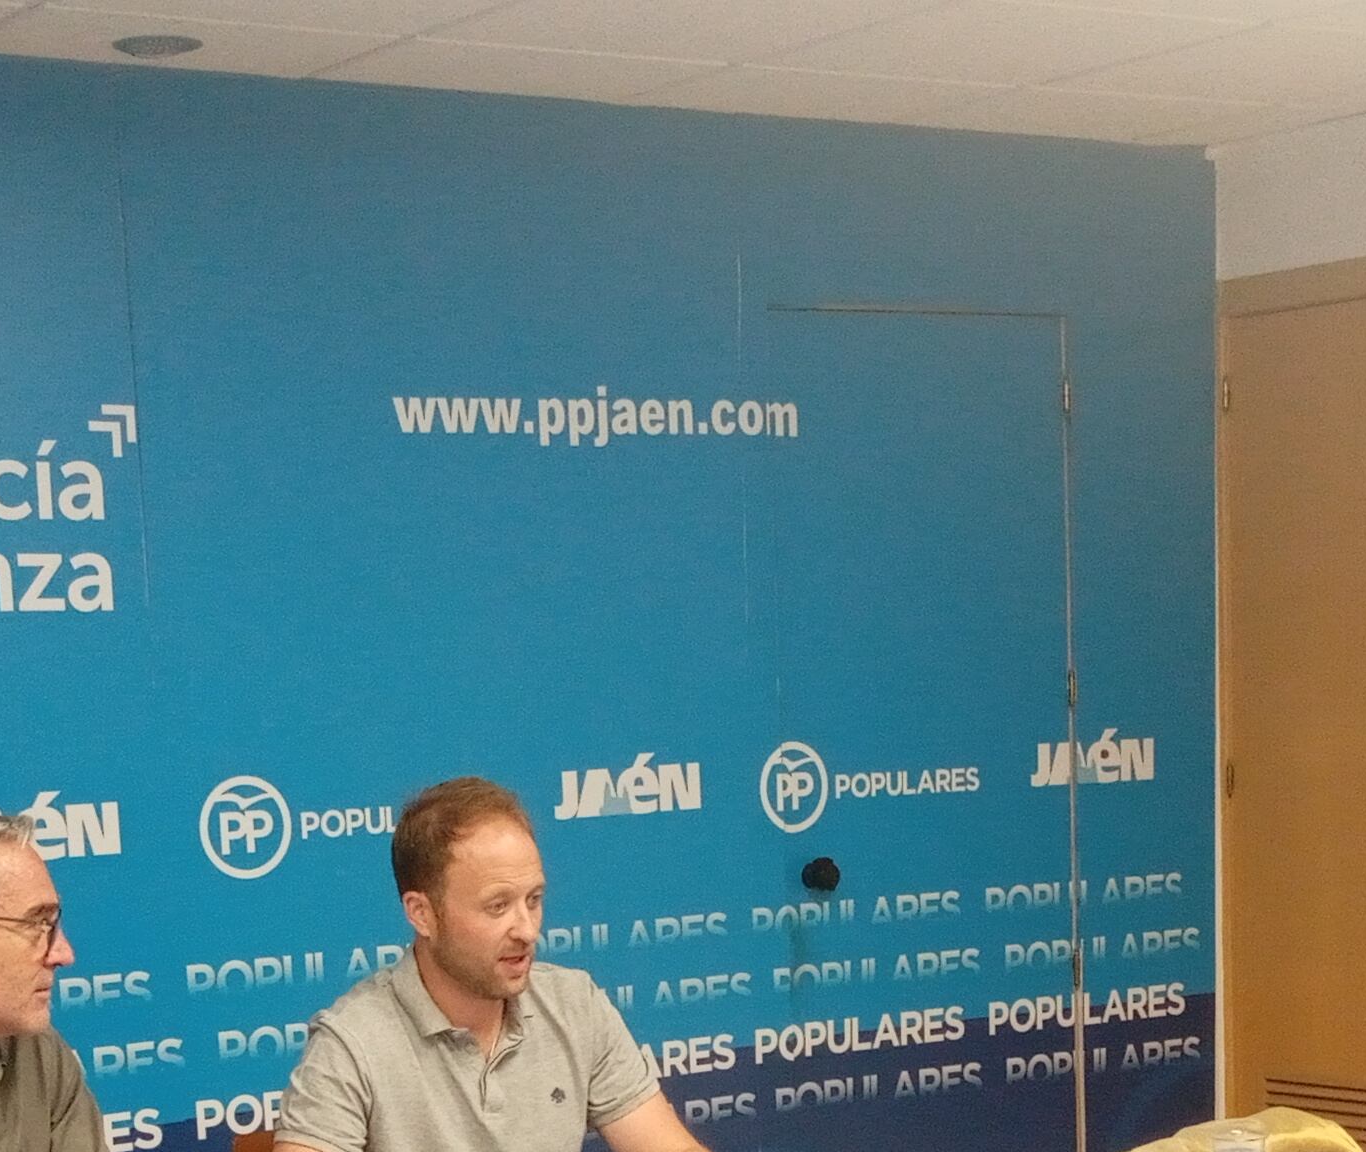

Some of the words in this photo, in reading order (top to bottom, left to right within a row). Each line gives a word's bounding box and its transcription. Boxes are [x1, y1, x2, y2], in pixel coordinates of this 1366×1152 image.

[392, 385, 799, 447] www.ppjaen.com
[835, 766, 980, 800] POPULARES
[754, 1005, 966, 1065] POPULARES
[988, 982, 1186, 1036] POPULARES
